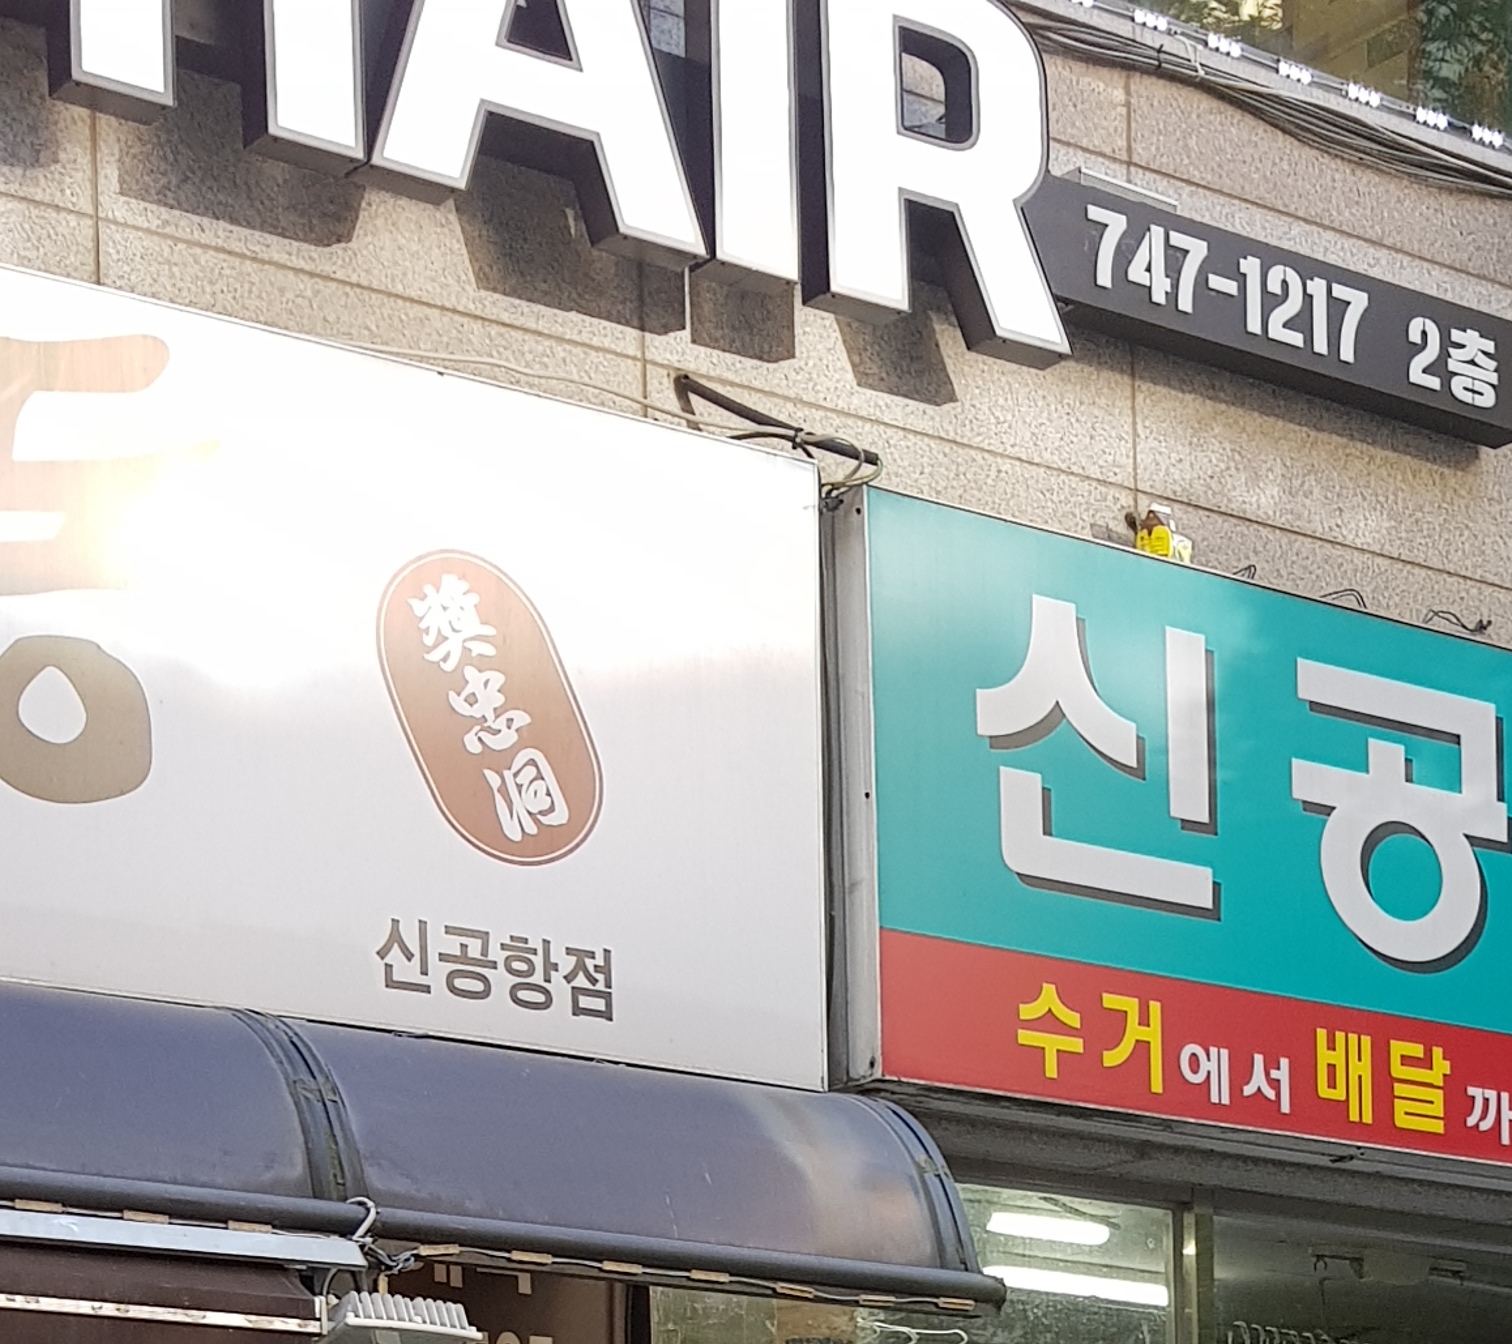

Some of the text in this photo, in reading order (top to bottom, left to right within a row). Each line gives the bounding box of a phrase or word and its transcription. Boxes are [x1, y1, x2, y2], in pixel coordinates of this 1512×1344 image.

[1086, 204, 1498, 409] 747-1217 2층
[376, 917, 614, 1022] 신공항점
[1017, 982, 1291, 1114] 수거에서
